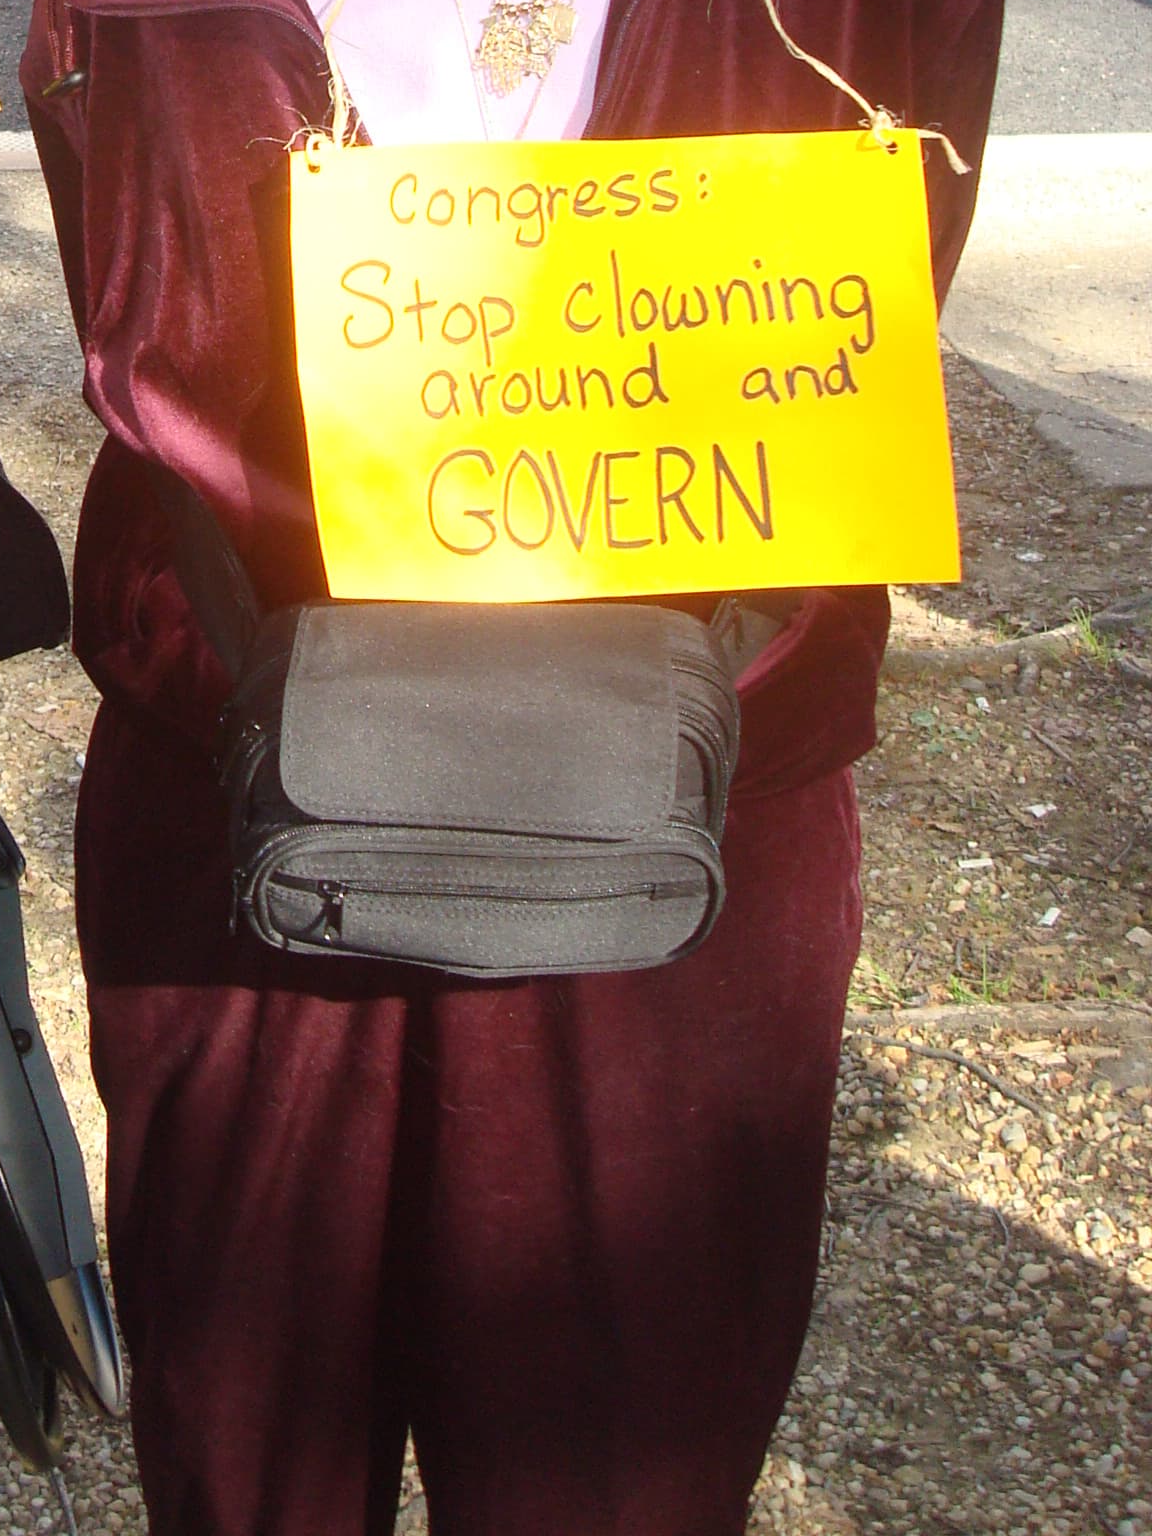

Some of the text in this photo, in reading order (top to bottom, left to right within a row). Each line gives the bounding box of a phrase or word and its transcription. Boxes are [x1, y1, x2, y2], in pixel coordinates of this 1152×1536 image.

[390, 169, 711, 246] Congress:
[341, 250, 876, 366] Stop clowning
[421, 343, 857, 419] around and
[428, 441, 774, 555] GOVERN
